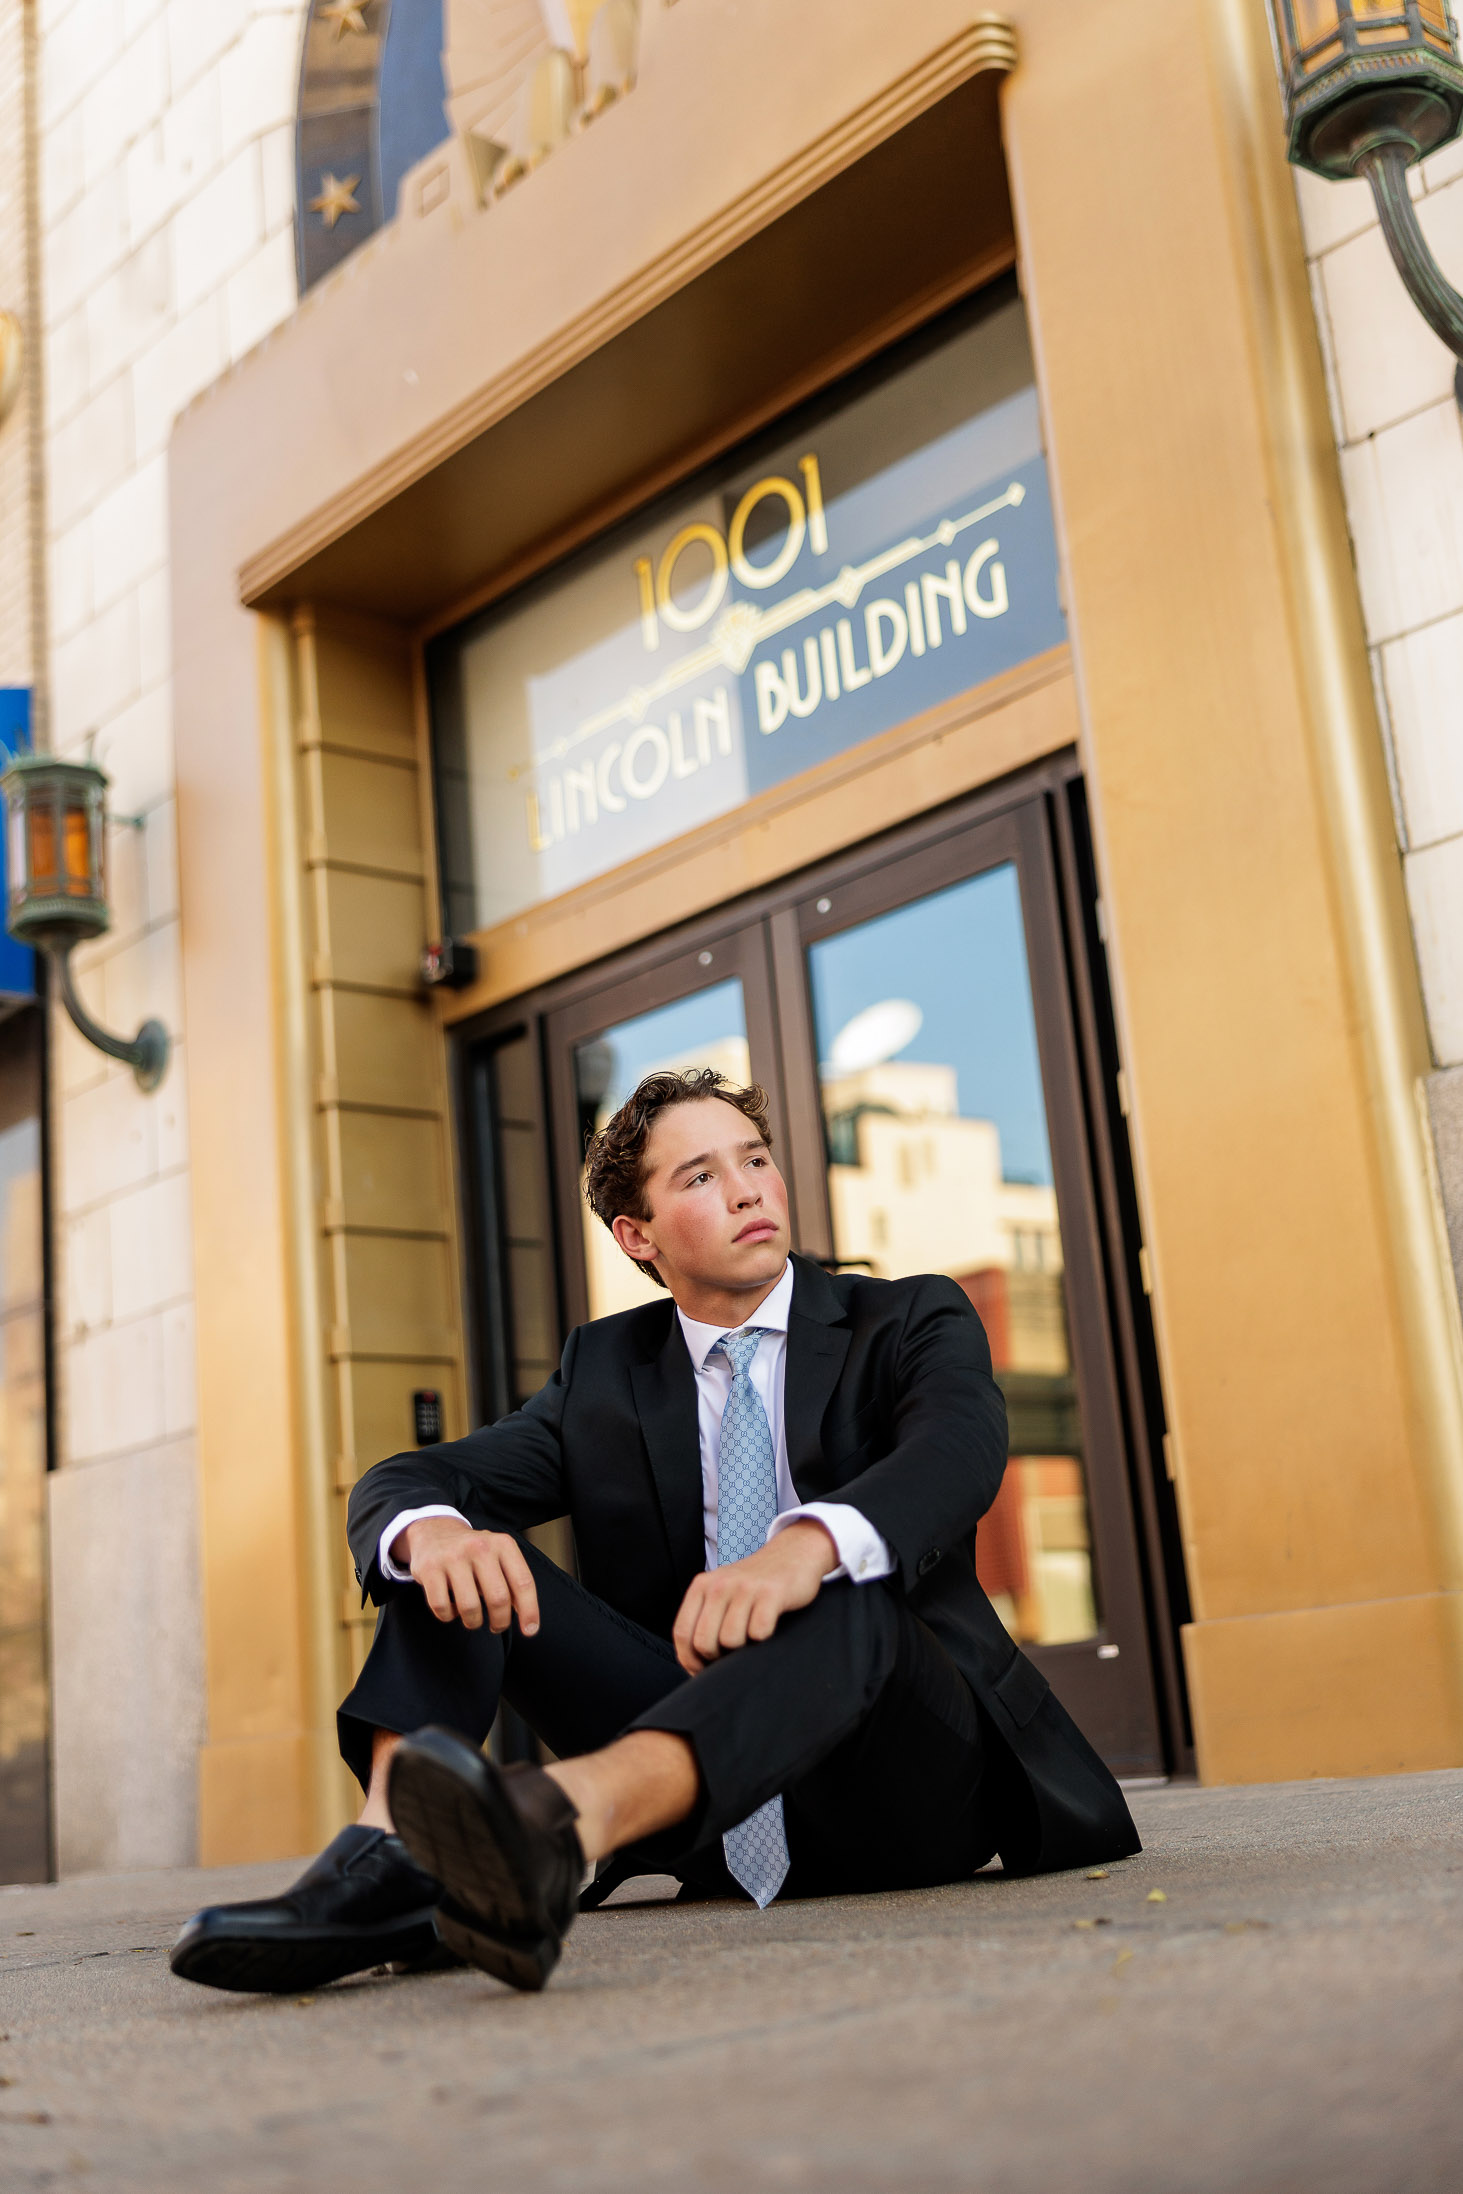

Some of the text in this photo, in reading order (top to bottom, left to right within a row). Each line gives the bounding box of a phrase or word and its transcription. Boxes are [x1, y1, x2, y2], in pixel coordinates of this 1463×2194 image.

[635, 454, 828, 651] 1001
[527, 538, 1009, 852] LINCOLN BUILDING
